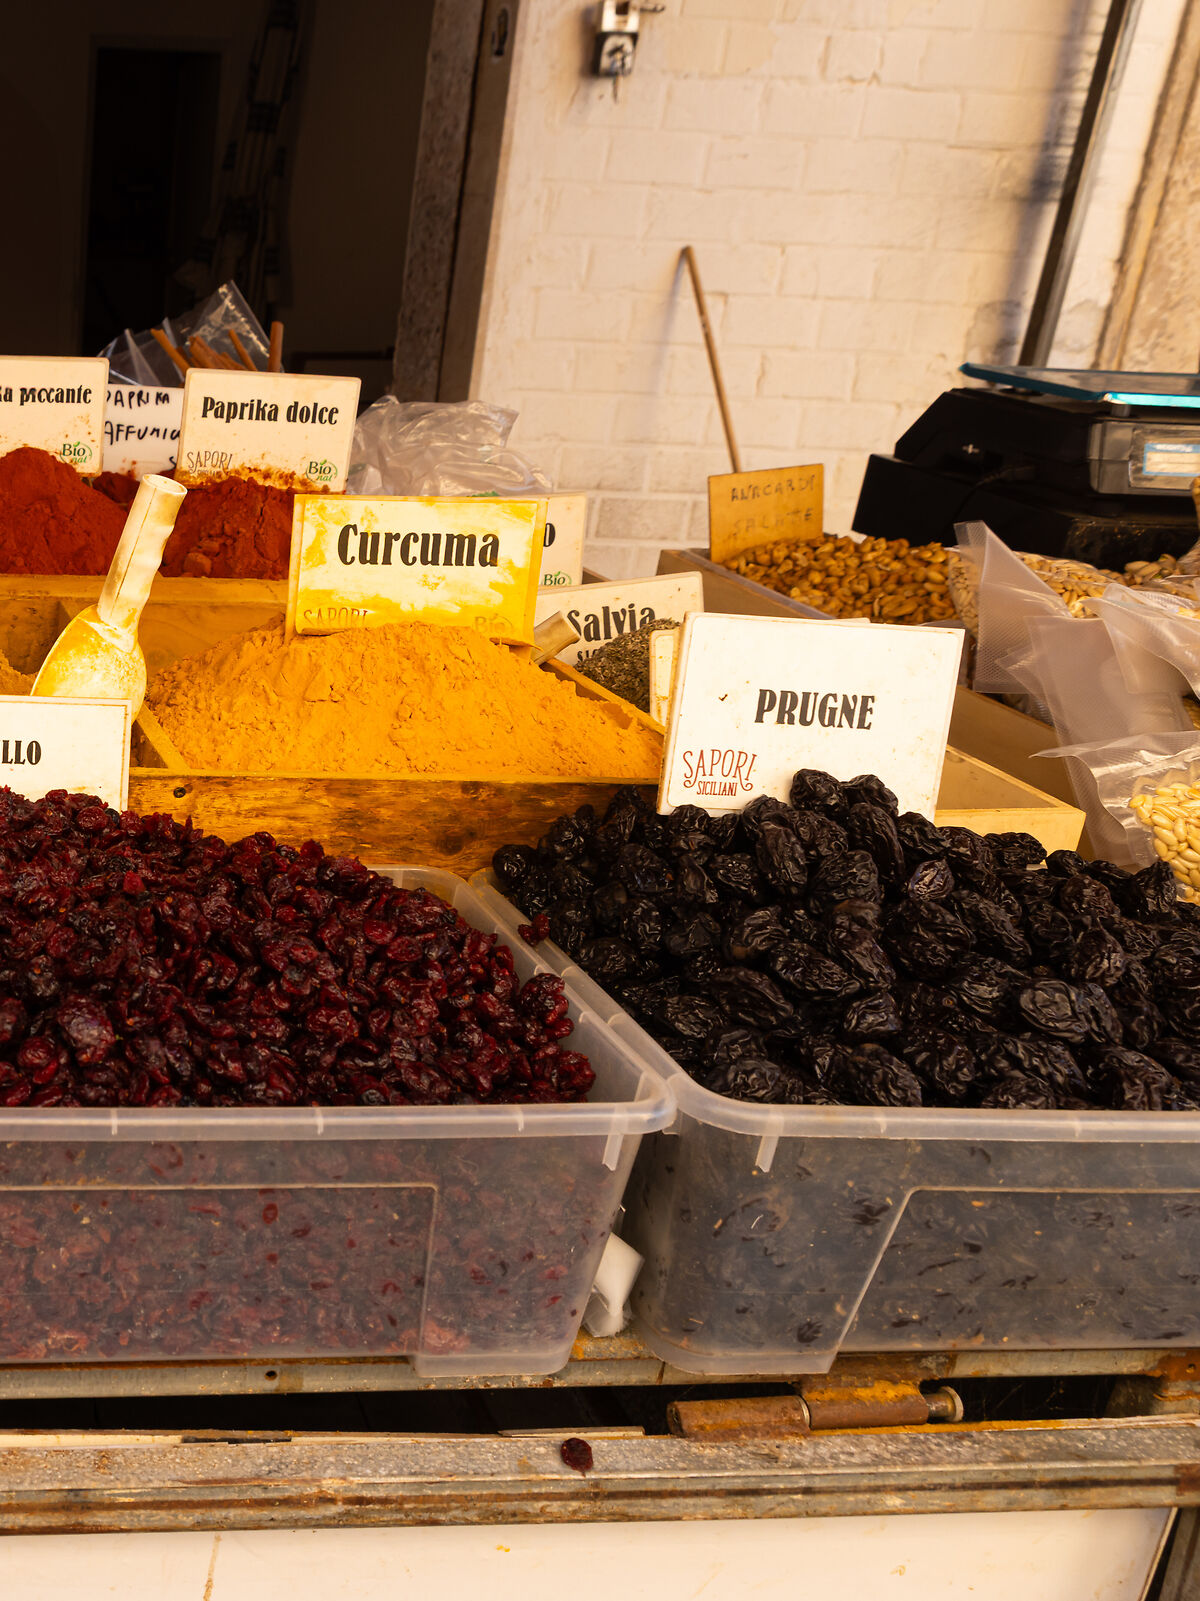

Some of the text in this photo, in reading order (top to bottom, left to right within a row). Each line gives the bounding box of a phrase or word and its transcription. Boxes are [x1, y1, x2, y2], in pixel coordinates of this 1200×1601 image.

[201, 396, 339, 425] Paprika dolce
[62, 442, 86, 457] Bio
[186, 450, 233, 475] SAPORI
[308, 460, 332, 476] Bio
[337, 523, 500, 567] Curcuma
[754, 688, 876, 731] PRUGNE
[682, 749, 758, 791] SAPORI
[696, 780, 738, 797] SICILIANI
